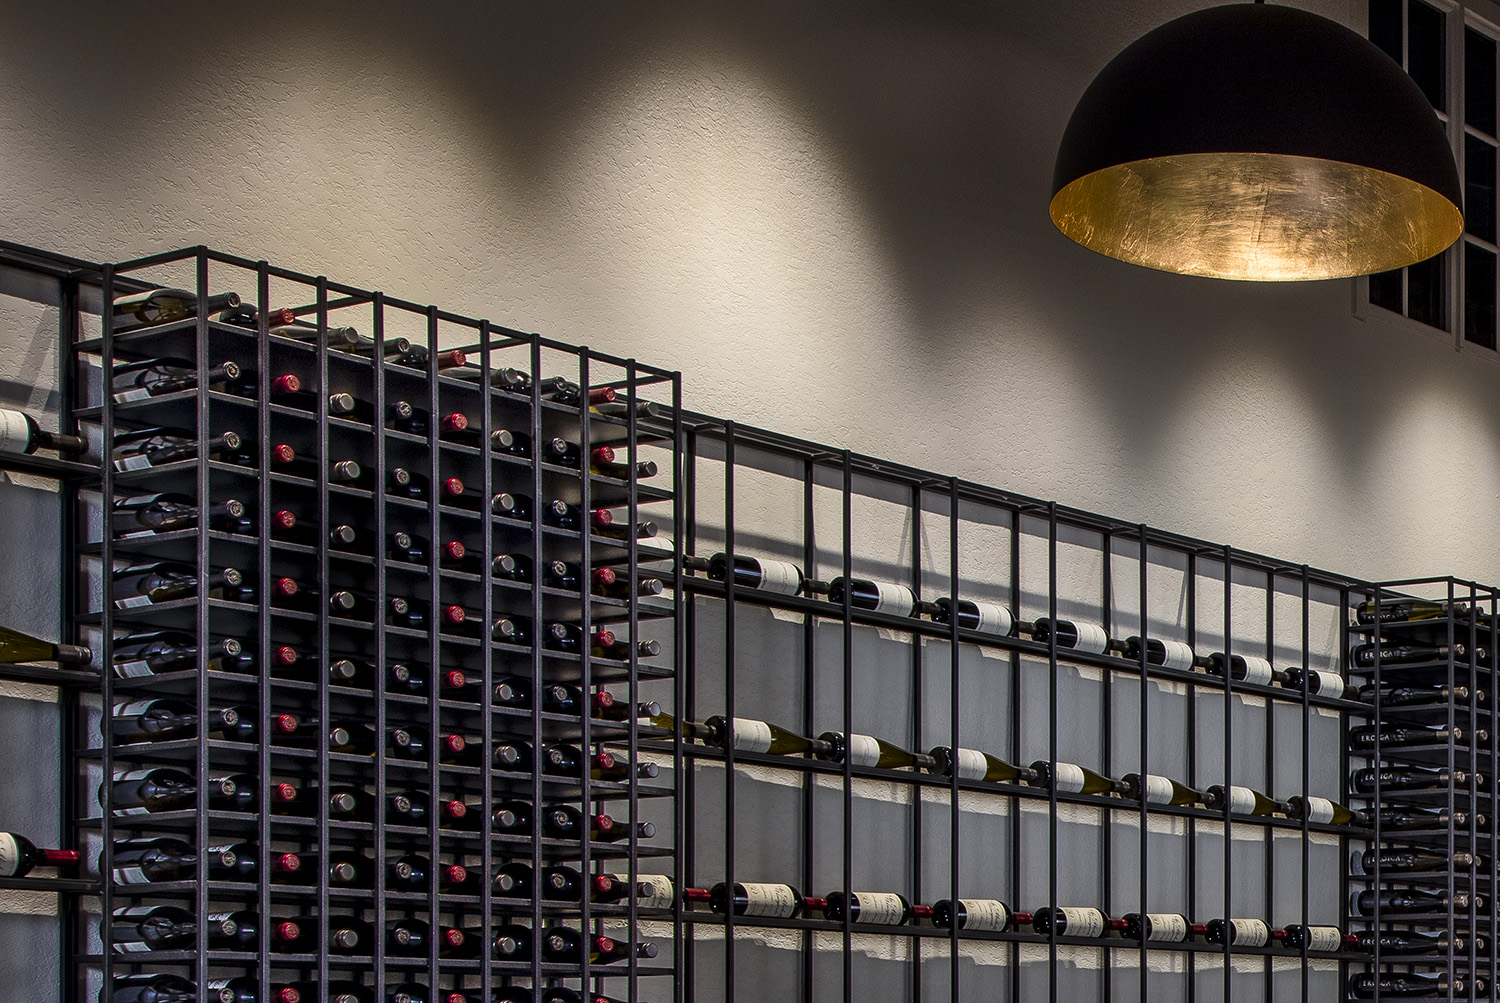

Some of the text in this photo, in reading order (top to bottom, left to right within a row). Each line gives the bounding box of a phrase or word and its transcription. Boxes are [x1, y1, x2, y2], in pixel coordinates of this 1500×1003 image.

[1364, 649, 1393, 660] ERICA
[1361, 734, 1390, 742] EROCA
[1364, 773, 1393, 781] ERICA
[1362, 979, 1391, 987] ERCA
